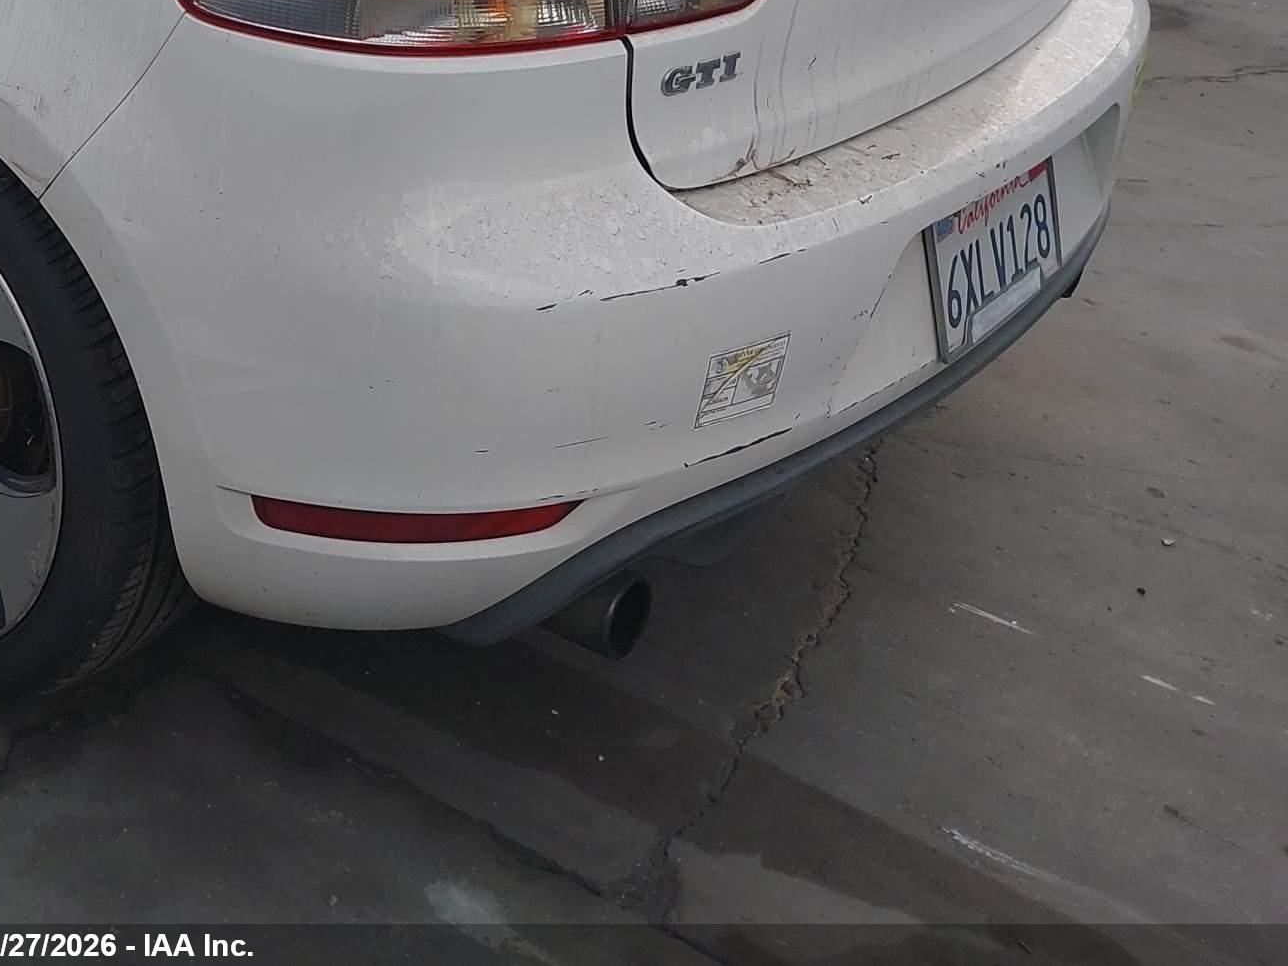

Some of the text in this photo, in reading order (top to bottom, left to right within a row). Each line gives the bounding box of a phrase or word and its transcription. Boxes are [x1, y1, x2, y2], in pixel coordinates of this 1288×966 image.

[660, 52, 741, 97] GTI
[956, 175, 1030, 234] California
[947, 193, 1051, 329] 6XLV128
